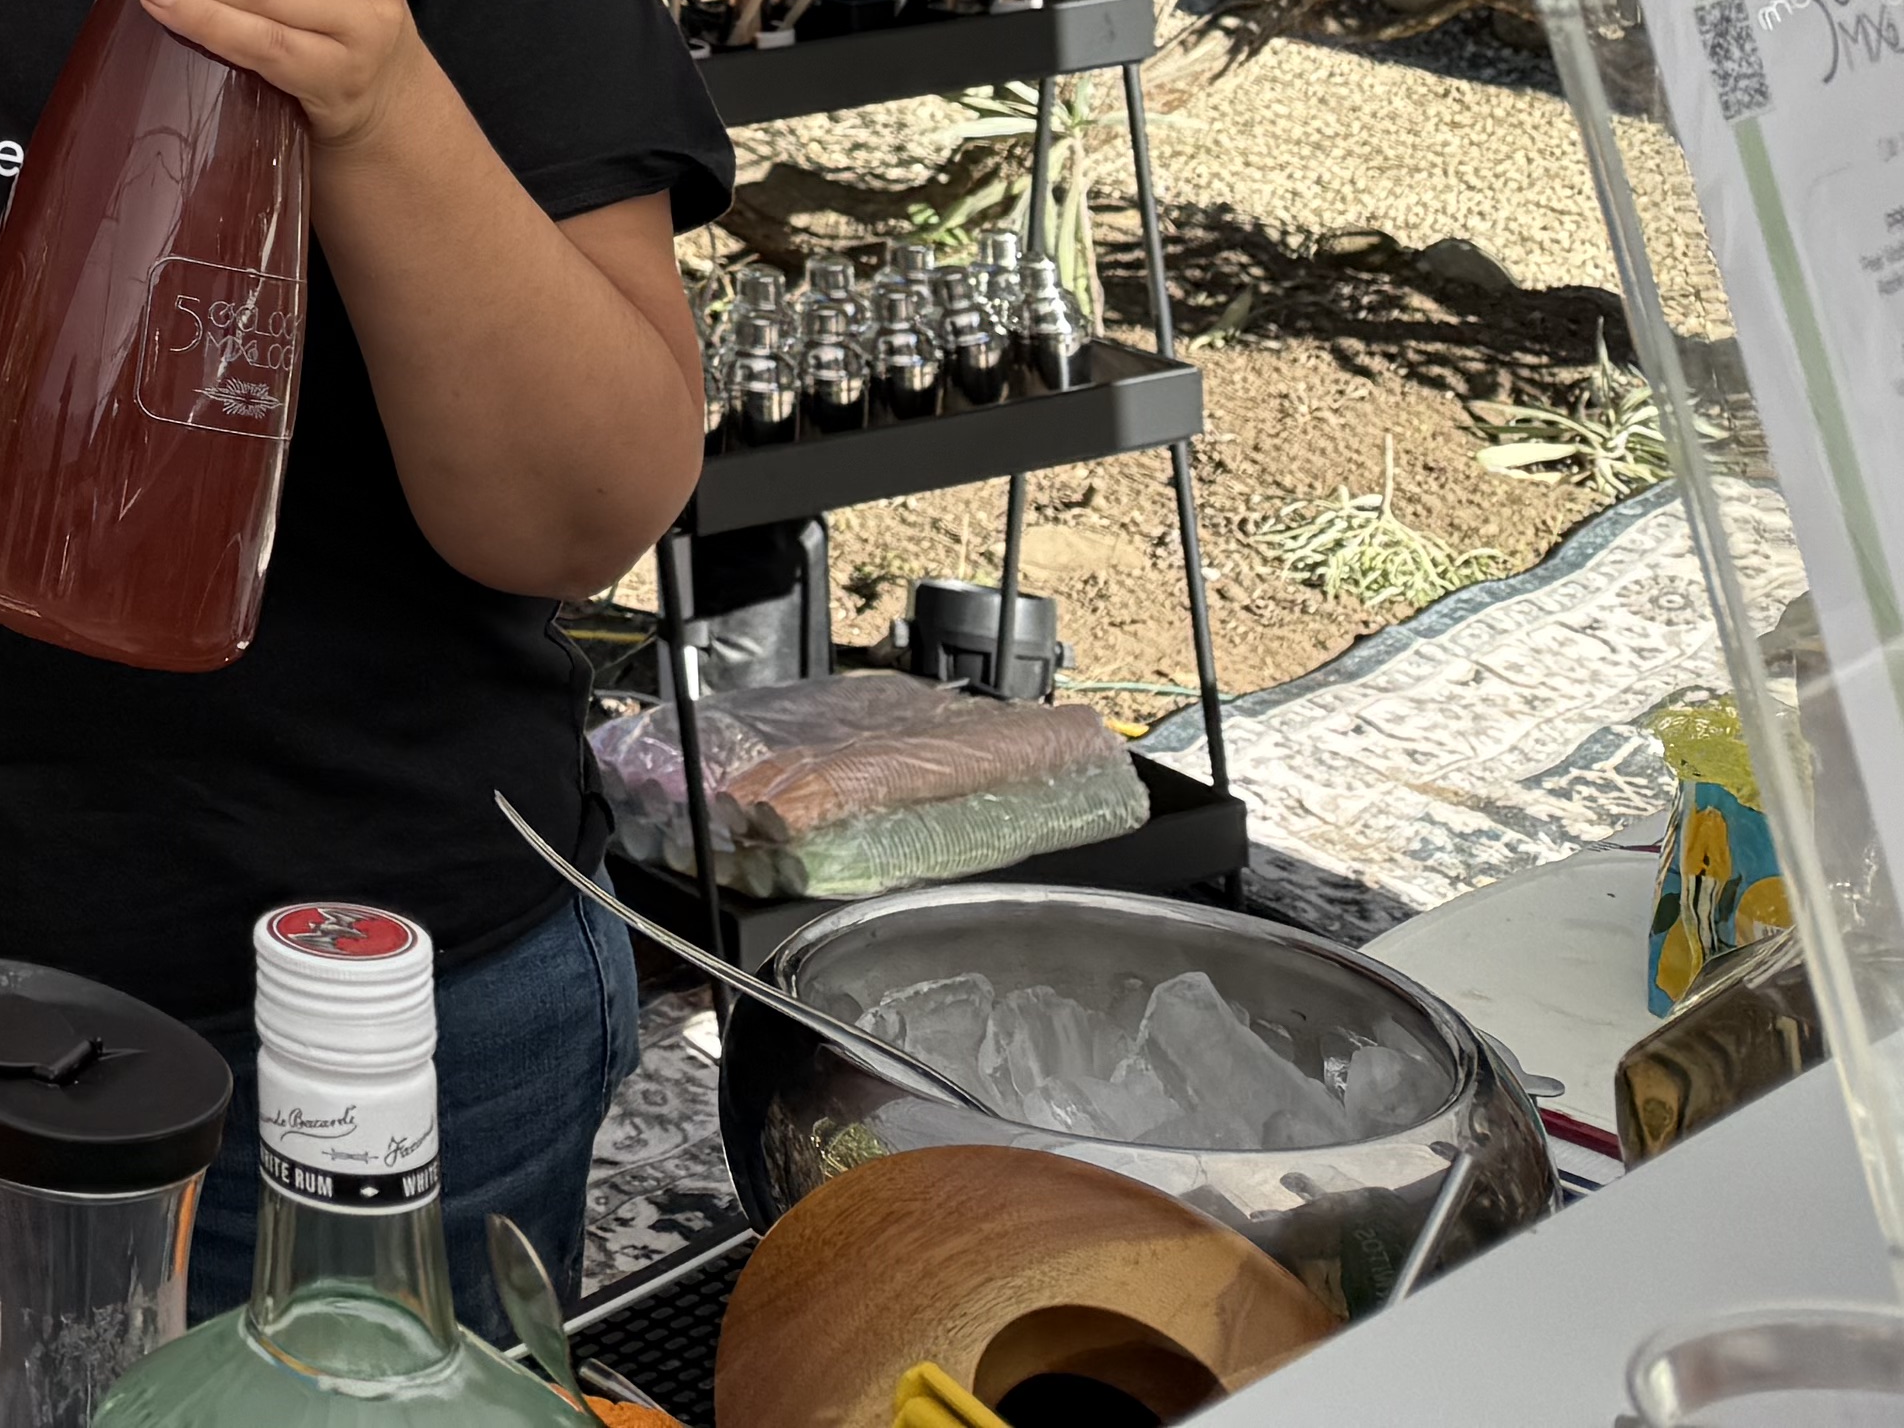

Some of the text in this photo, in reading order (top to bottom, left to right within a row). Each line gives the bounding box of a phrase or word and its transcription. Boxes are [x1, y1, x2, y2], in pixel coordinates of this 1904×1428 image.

[170, 294, 203, 352] 5
[295, 1167, 333, 1198] RUM
[403, 1162, 438, 1198] WHITE
